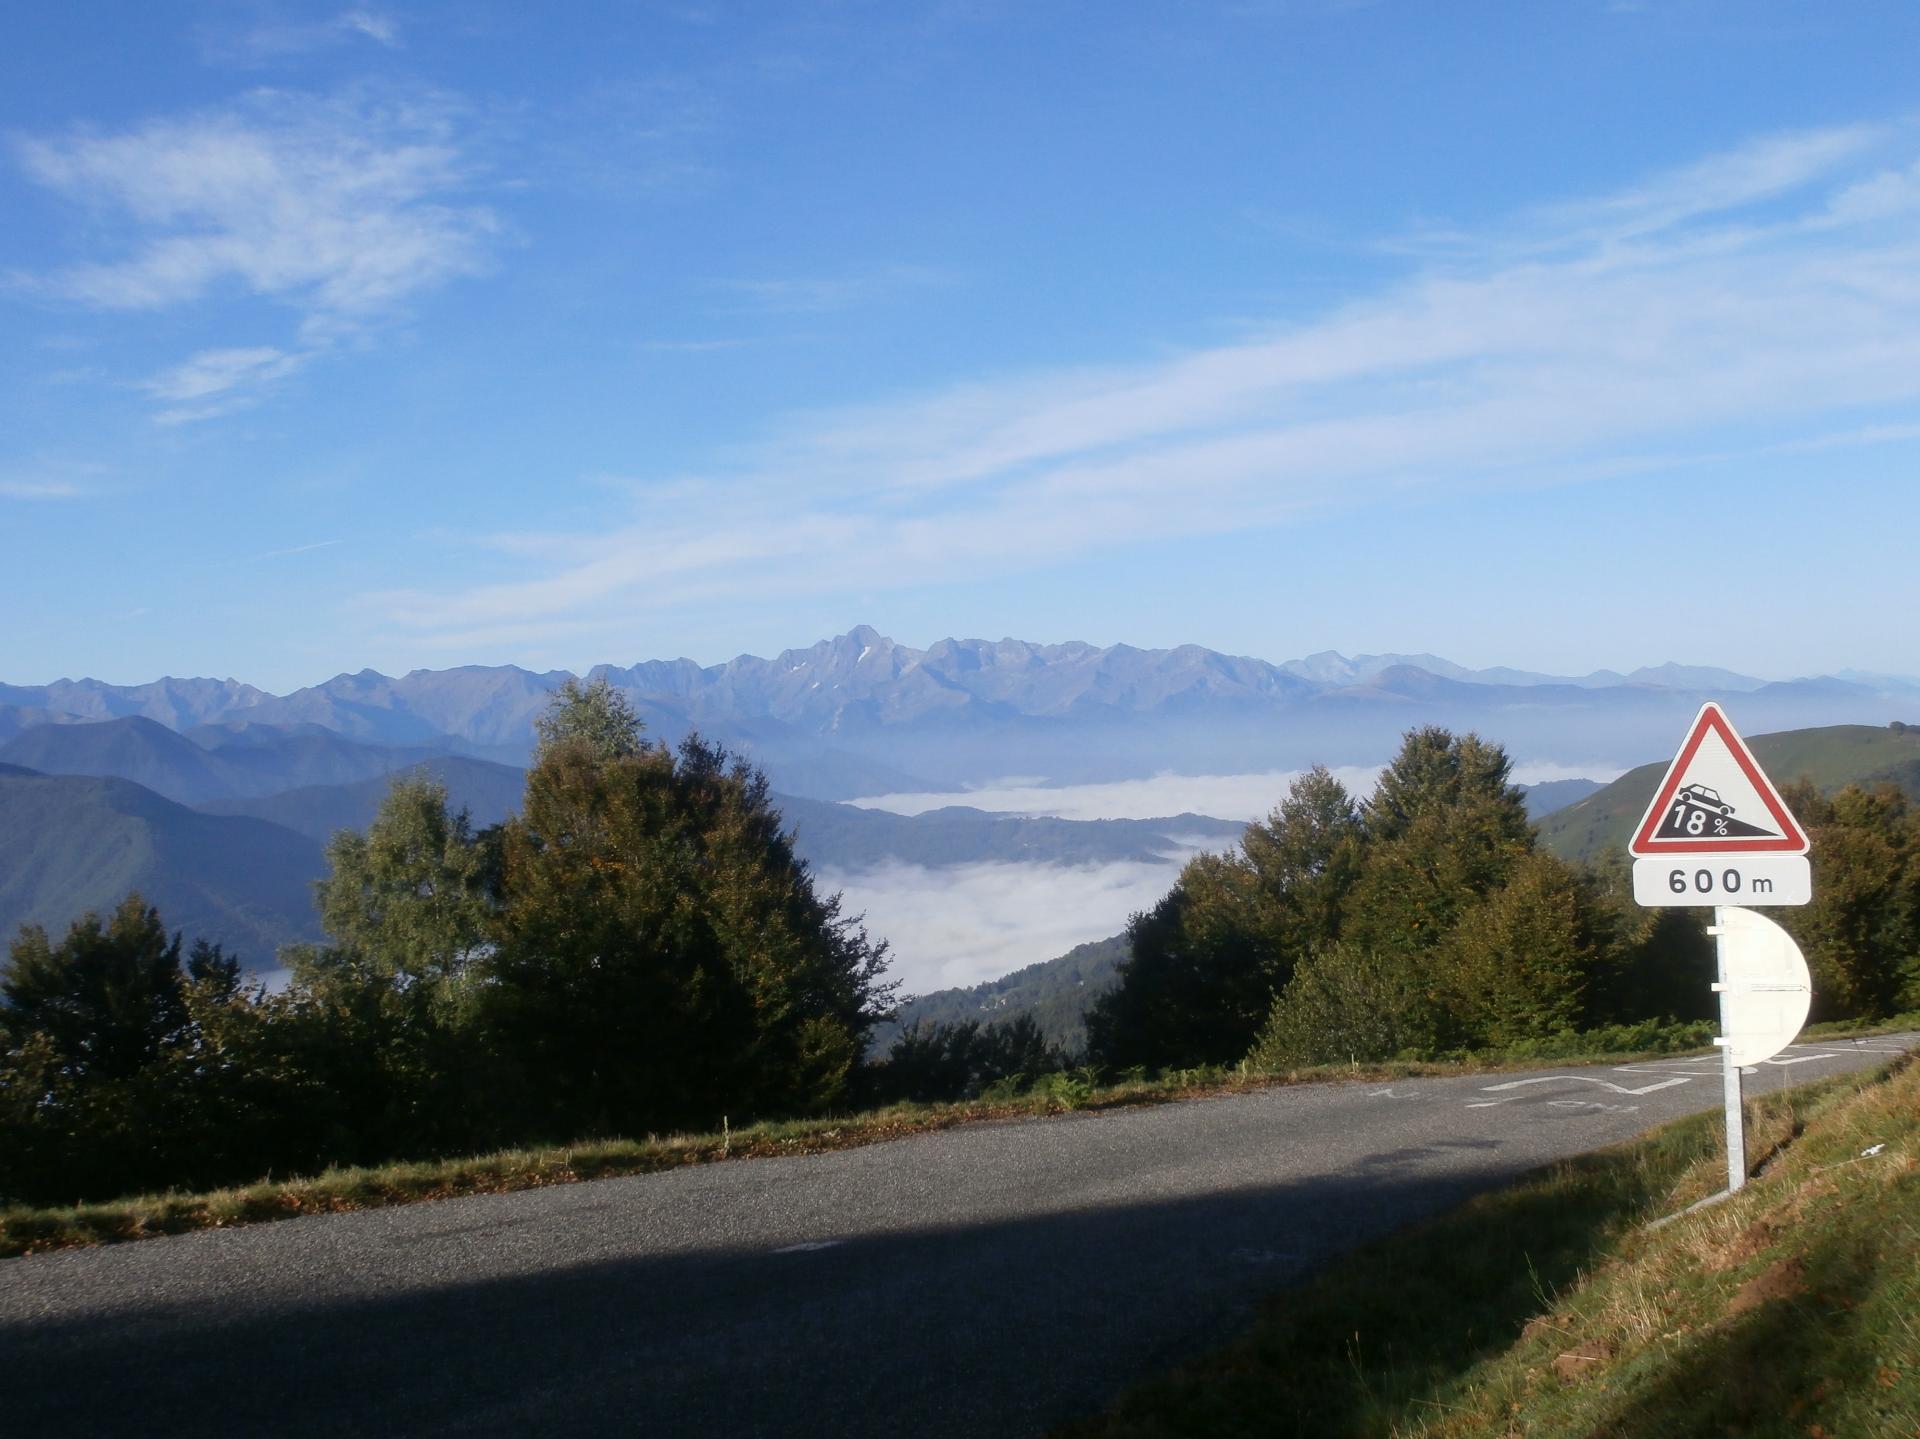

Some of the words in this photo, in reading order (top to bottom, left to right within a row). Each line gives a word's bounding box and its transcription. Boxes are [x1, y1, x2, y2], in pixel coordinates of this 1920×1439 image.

[1673, 804, 1706, 835] 18
[1713, 818, 1728, 836] %
[1668, 868, 1741, 894] 600
[1752, 878, 1773, 893] m
